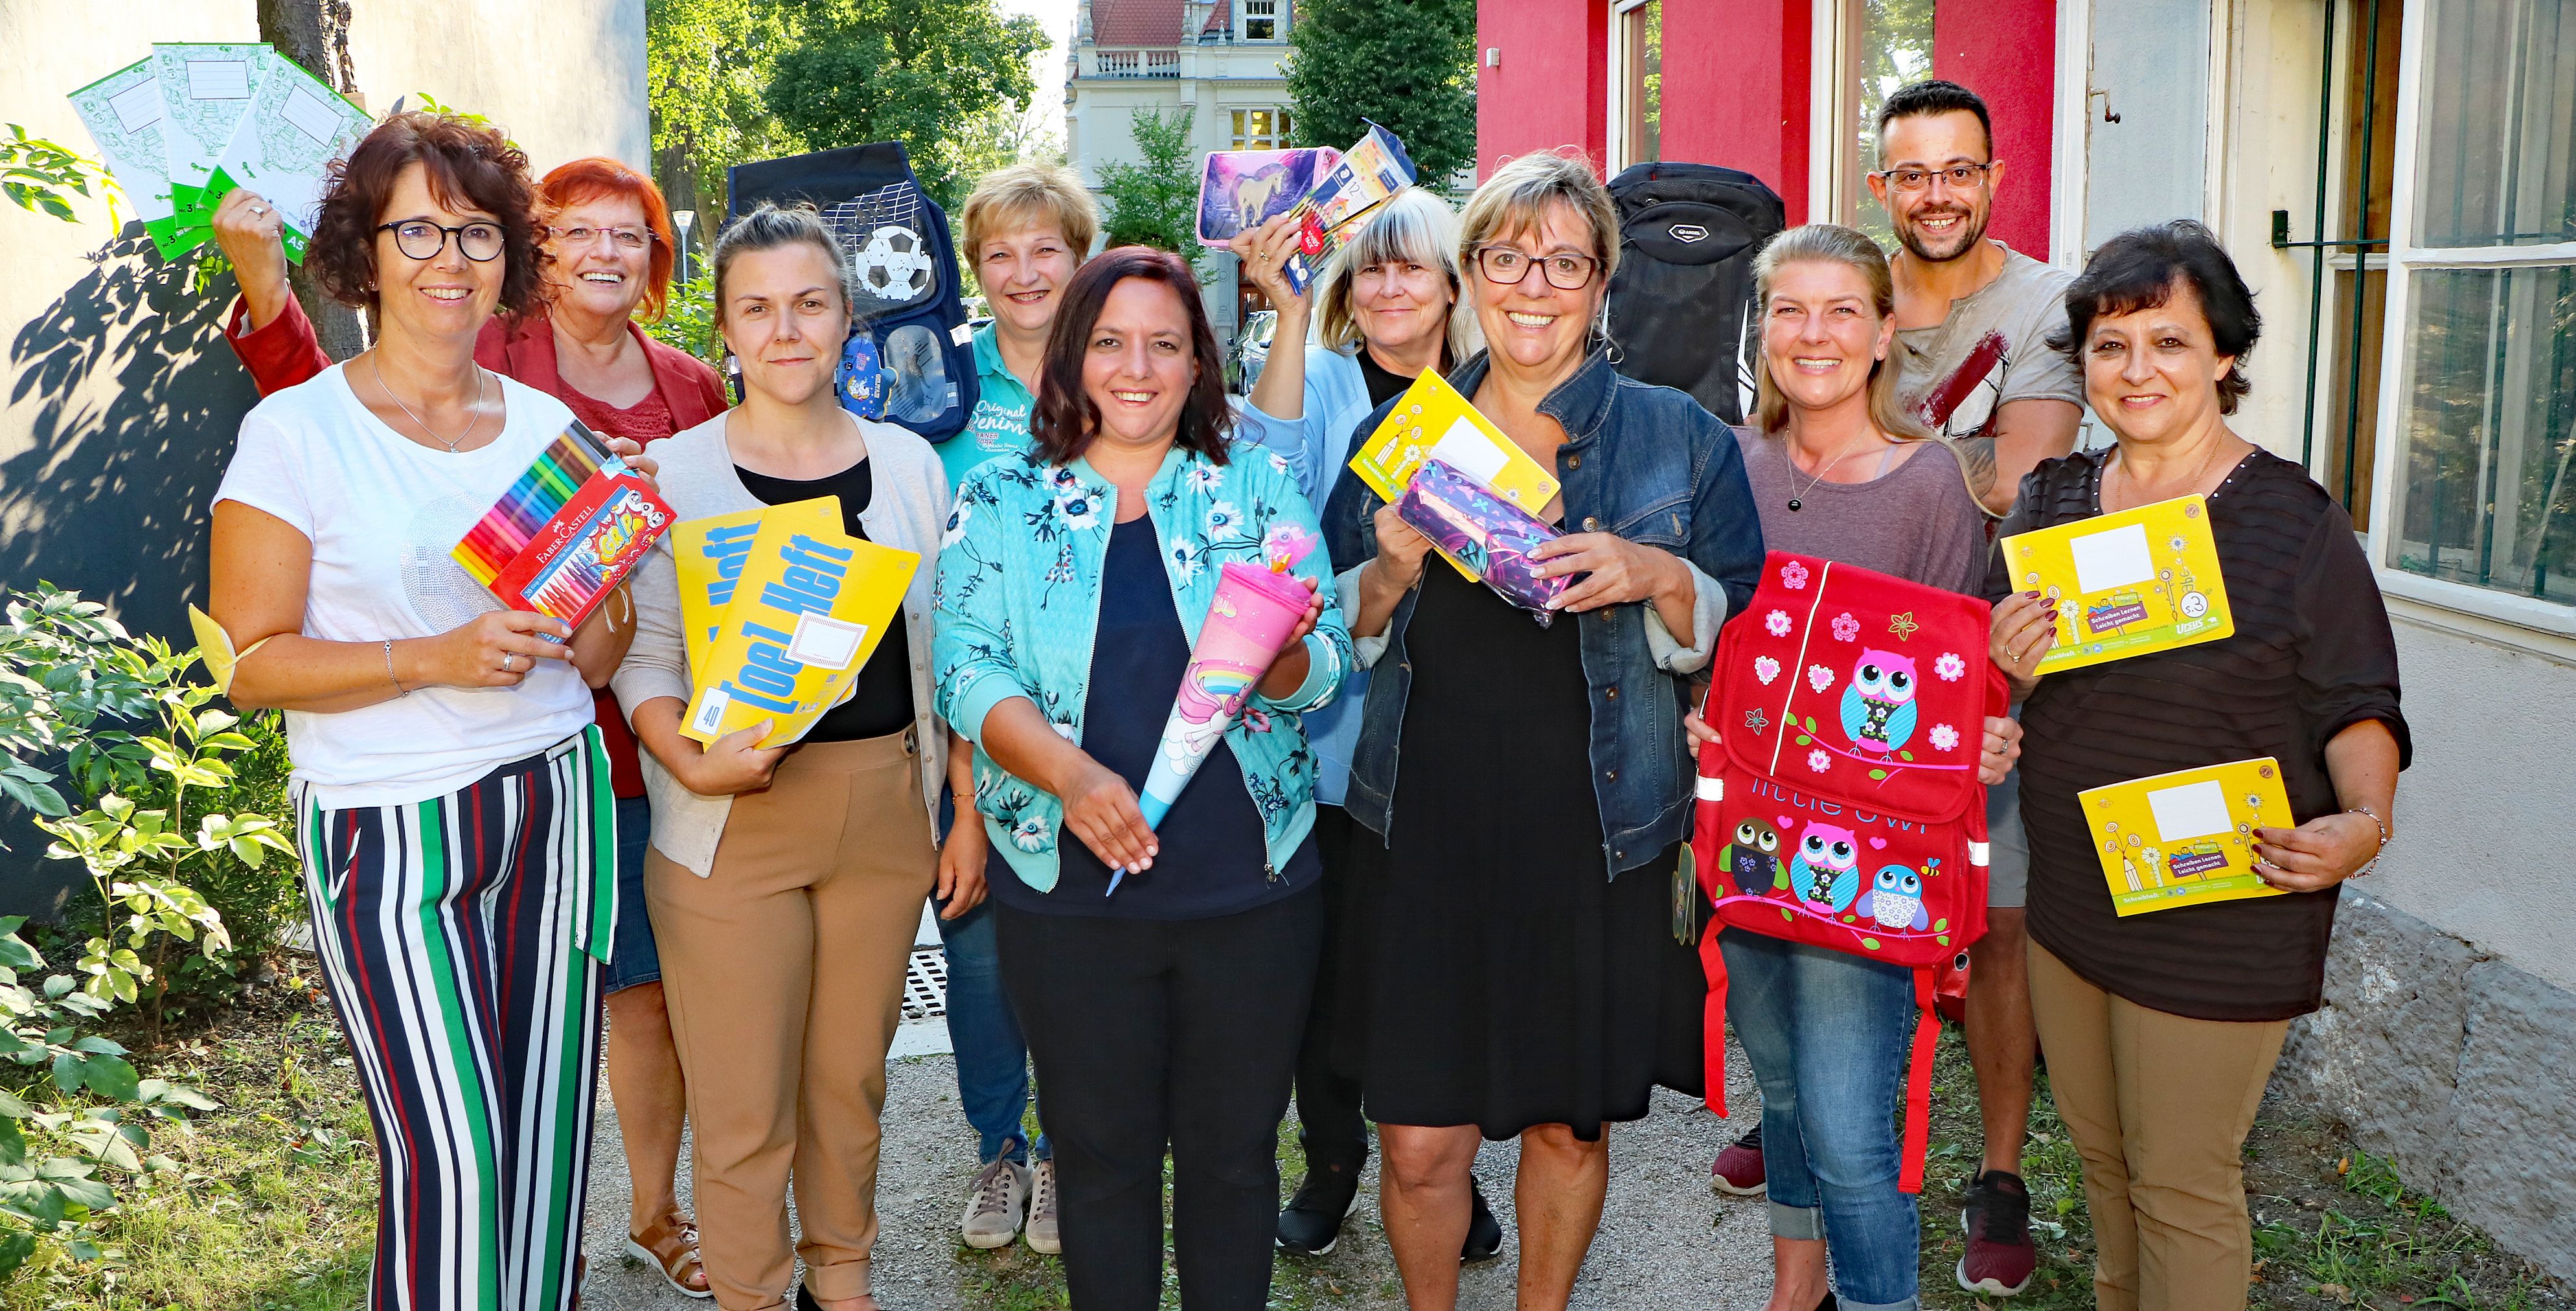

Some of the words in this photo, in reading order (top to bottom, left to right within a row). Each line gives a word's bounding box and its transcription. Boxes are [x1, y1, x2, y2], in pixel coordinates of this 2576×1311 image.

[216, 191, 223, 200] 3
[1348, 181, 1360, 196] 12
[187, 204, 193, 212] 3
[168, 235, 176, 244] 3
[287, 236, 305, 251] A5
[1305, 236, 1314, 249] PACK
[1308, 230, 1320, 247] BONUS
[976, 400, 1027, 418] Original
[536, 505, 595, 564] FABER-CASTELL
[759, 534, 854, 617] Heft
[525, 588, 533, 597] 20
[2091, 611, 2121, 624] Schreiben
[2121, 606, 2141, 615] Lernen
[2095, 621, 2114, 630] Leicht
[2114, 613, 2140, 625] gemacht
[703, 705, 720, 727] 40
[2172, 858, 2202, 869] Schreiben
[2196, 861, 2221, 871] gemacht
[2123, 893, 2160, 903] Schreibheft
